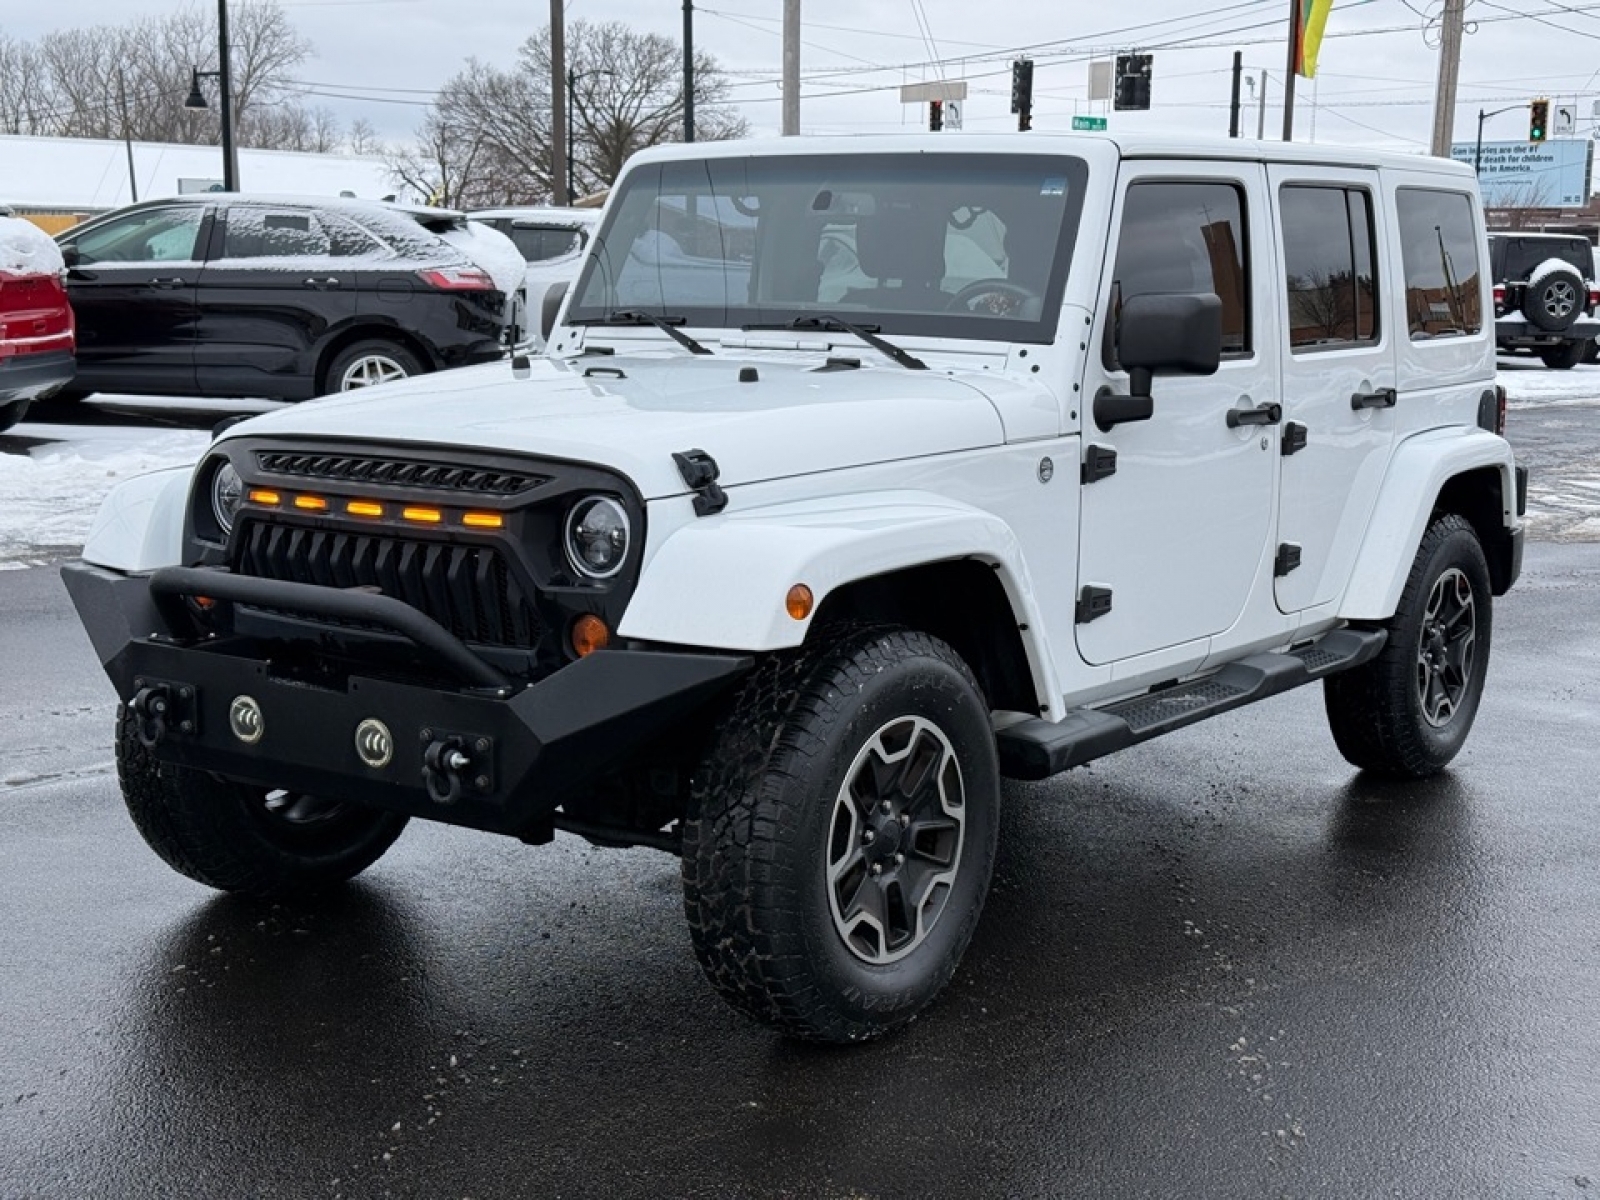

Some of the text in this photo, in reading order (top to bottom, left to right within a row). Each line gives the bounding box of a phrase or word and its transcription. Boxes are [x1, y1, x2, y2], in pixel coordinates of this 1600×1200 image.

[1484, 155, 1506, 164] death
[1508, 155, 1520, 163] for
[1521, 155, 1554, 163] children
